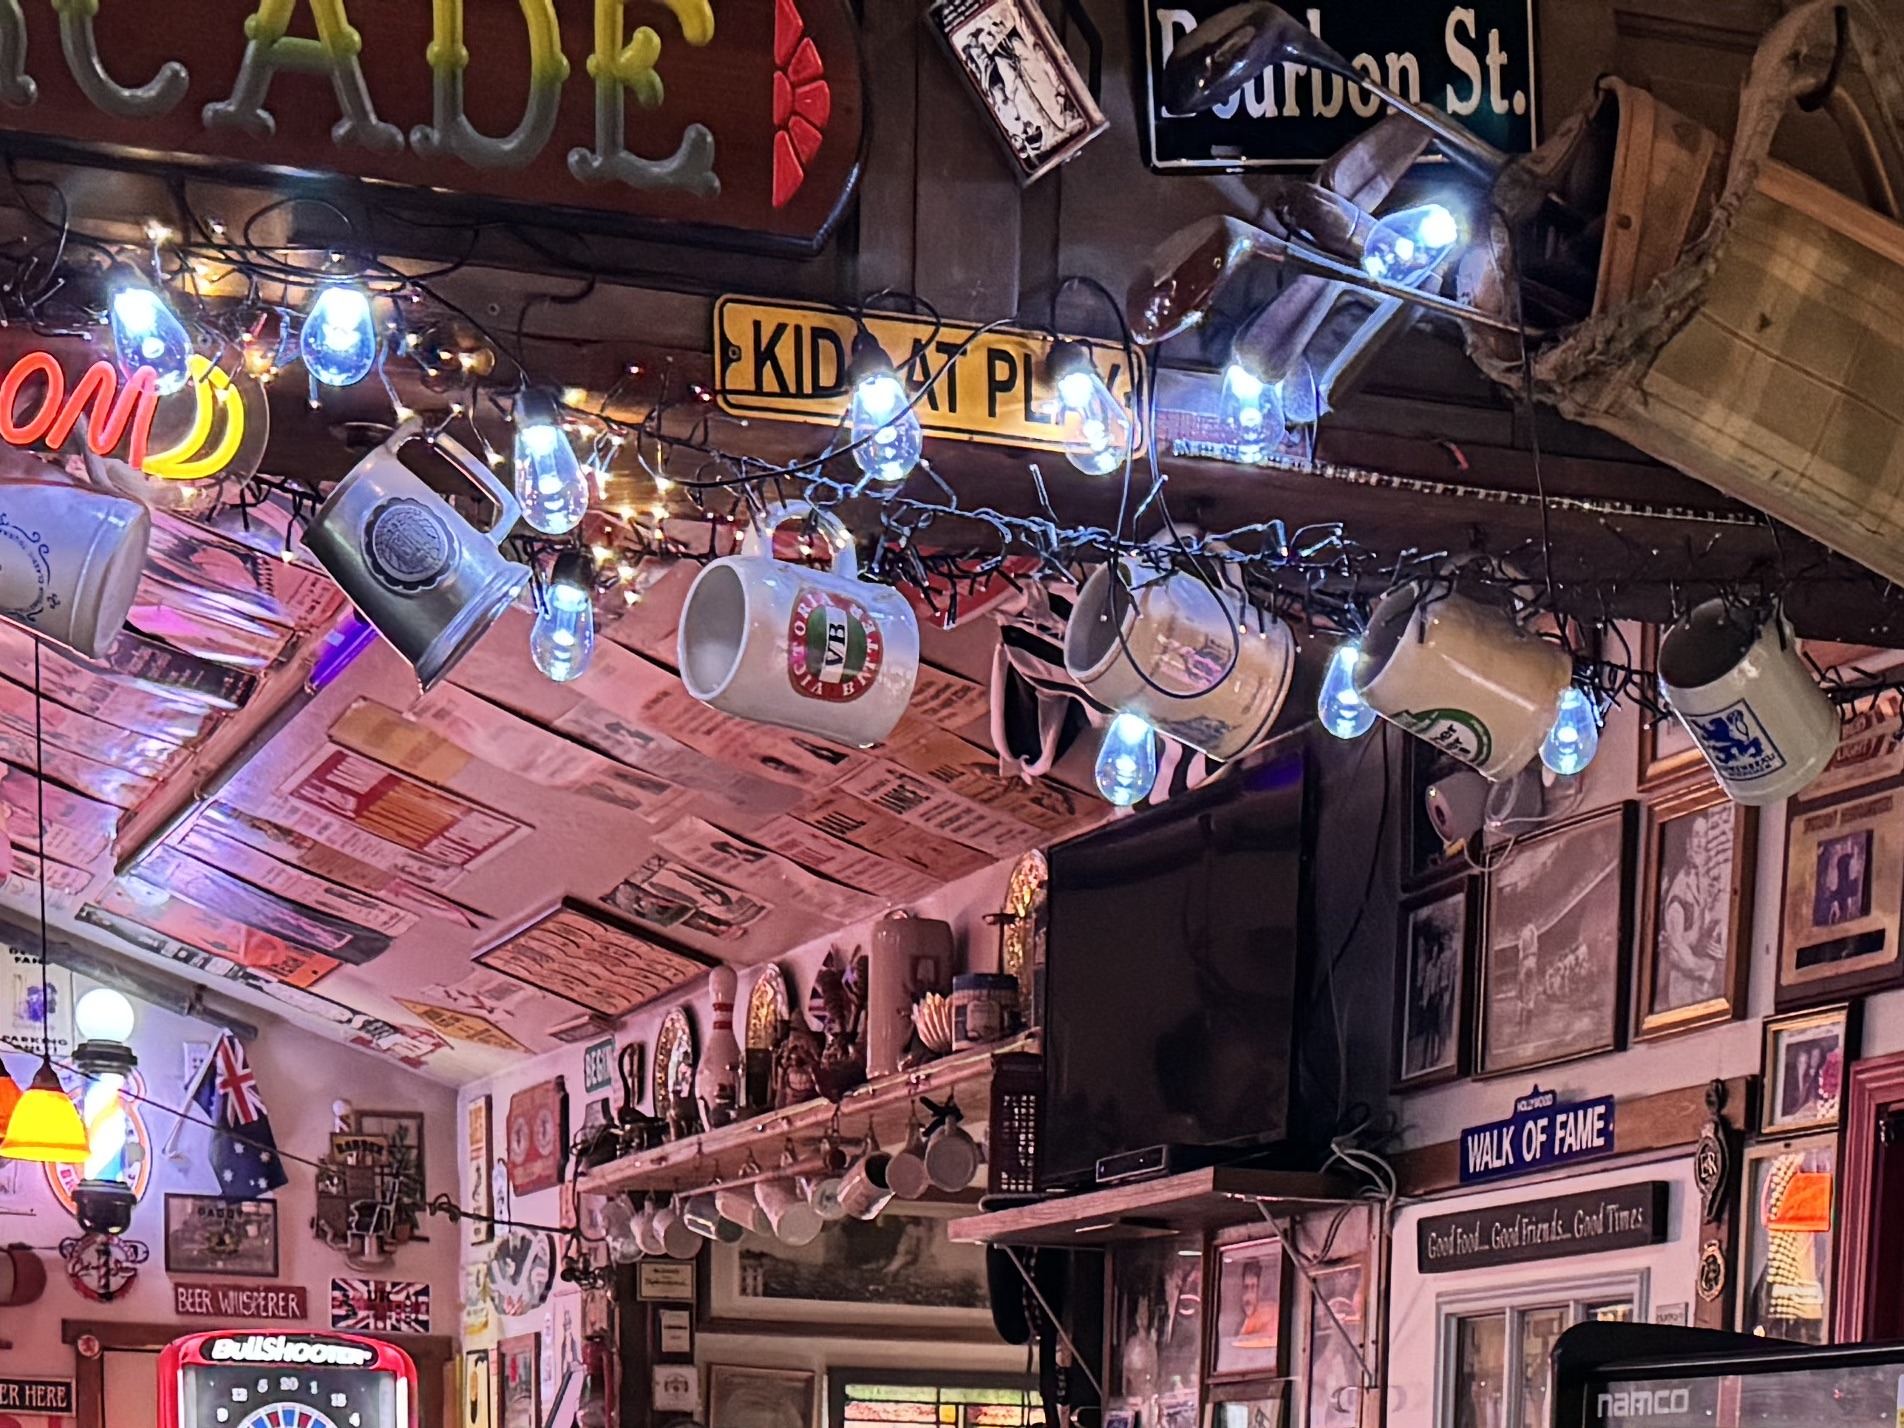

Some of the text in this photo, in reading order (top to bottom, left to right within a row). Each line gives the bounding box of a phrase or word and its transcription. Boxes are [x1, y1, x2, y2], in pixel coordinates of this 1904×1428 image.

[1446, 6, 1526, 117] St.
[752, 319, 851, 396] KID
[910, 338, 967, 413] AT
[824, 623, 846, 667] VB
[1467, 1104, 1606, 1174] WALK OF FAME
[1428, 1226, 1454, 1260] Good
[1492, 1214, 1520, 1250] Good
[1574, 1202, 1603, 1239] Good
[1607, 1204, 1644, 1234] Times
[177, 1286, 301, 1319] BEER WHISPERER
[24, 1384, 68, 1409] HERE
[1597, 1387, 1690, 1418] namco
